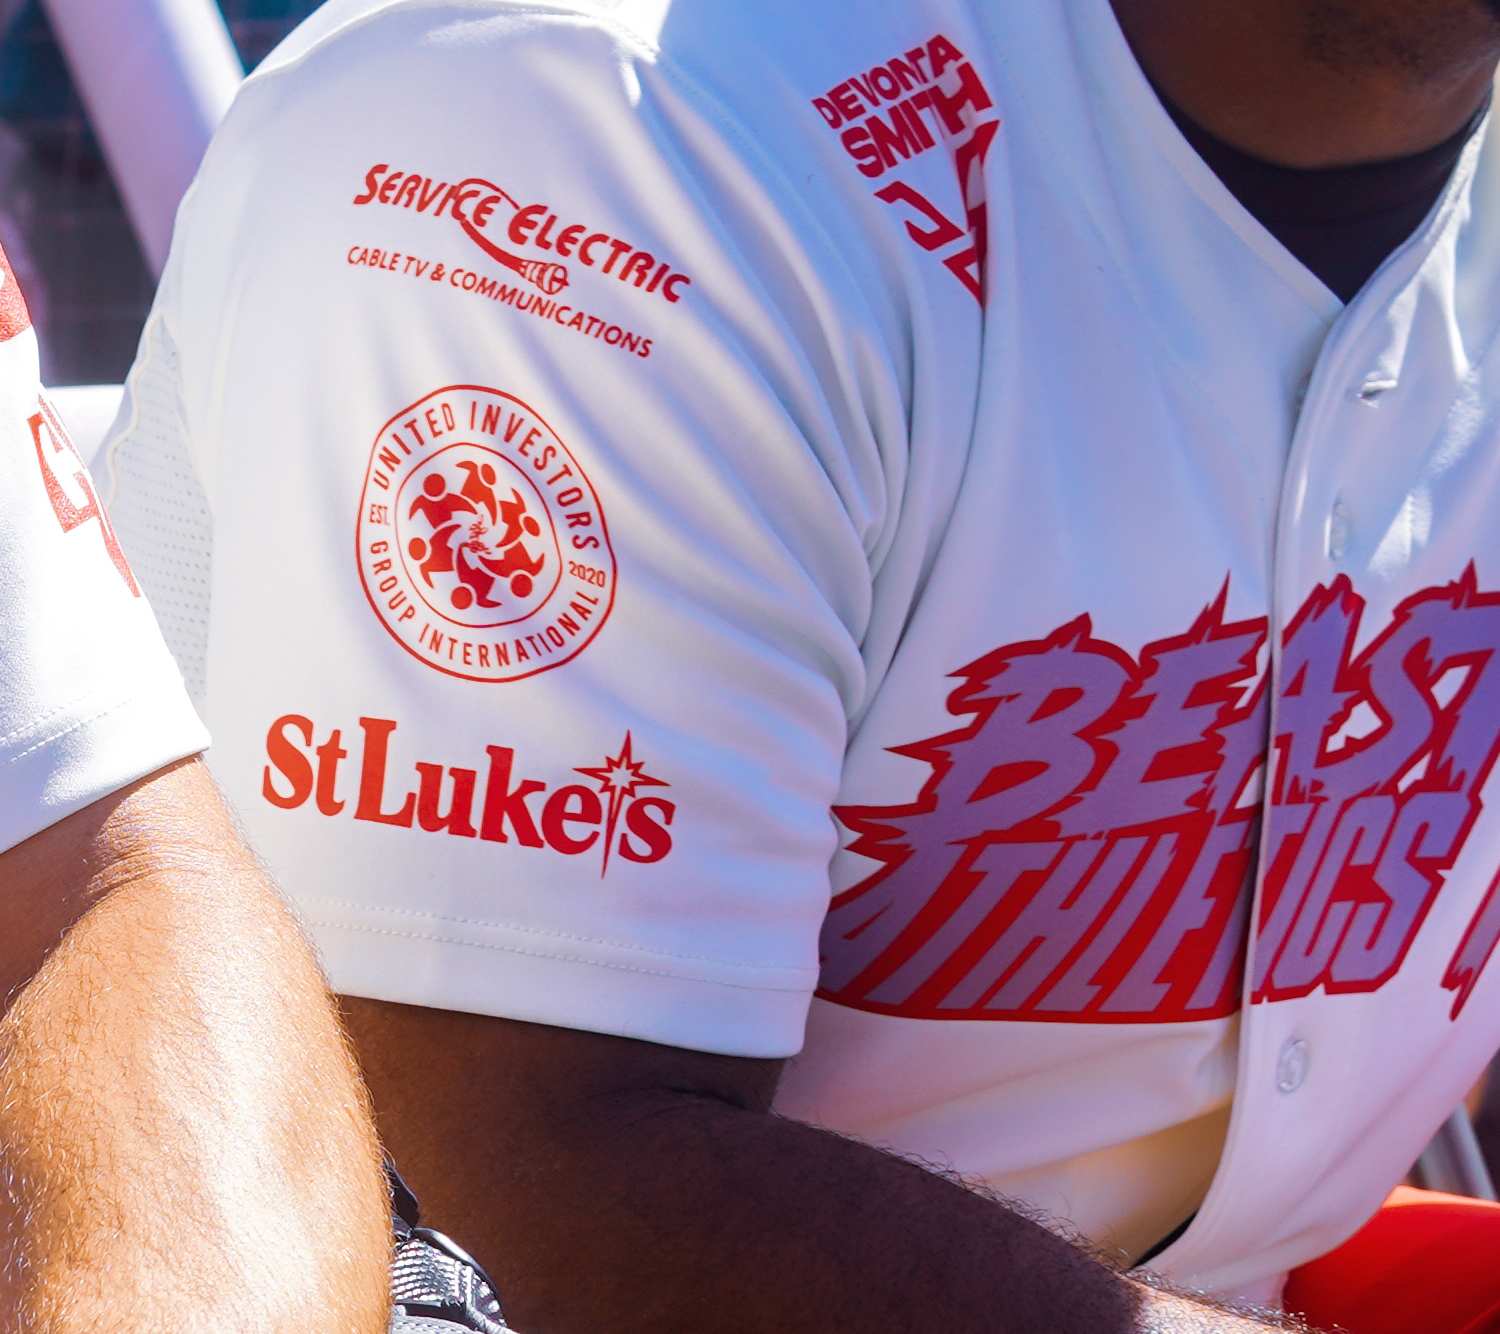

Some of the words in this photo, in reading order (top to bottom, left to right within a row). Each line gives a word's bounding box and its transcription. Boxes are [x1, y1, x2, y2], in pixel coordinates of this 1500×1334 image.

[809, 32, 966, 130] DEVONTA
[838, 61, 995, 179] SMITH
[352, 162, 502, 228] SERVICE
[506, 203, 693, 304] ELECTRIC
[346, 245, 402, 271] CABLE
[402, 254, 431, 278] TV
[430, 262, 446, 283] &
[449, 267, 655, 359] COMMUNICATIONS
[372, 401, 456, 491] UNITED
[469, 399, 601, 551] INVESTORS
[369, 539, 416, 623] GROUP
[417, 589, 601, 669] INTERNATIONAL
[566, 559, 608, 589] 2020
